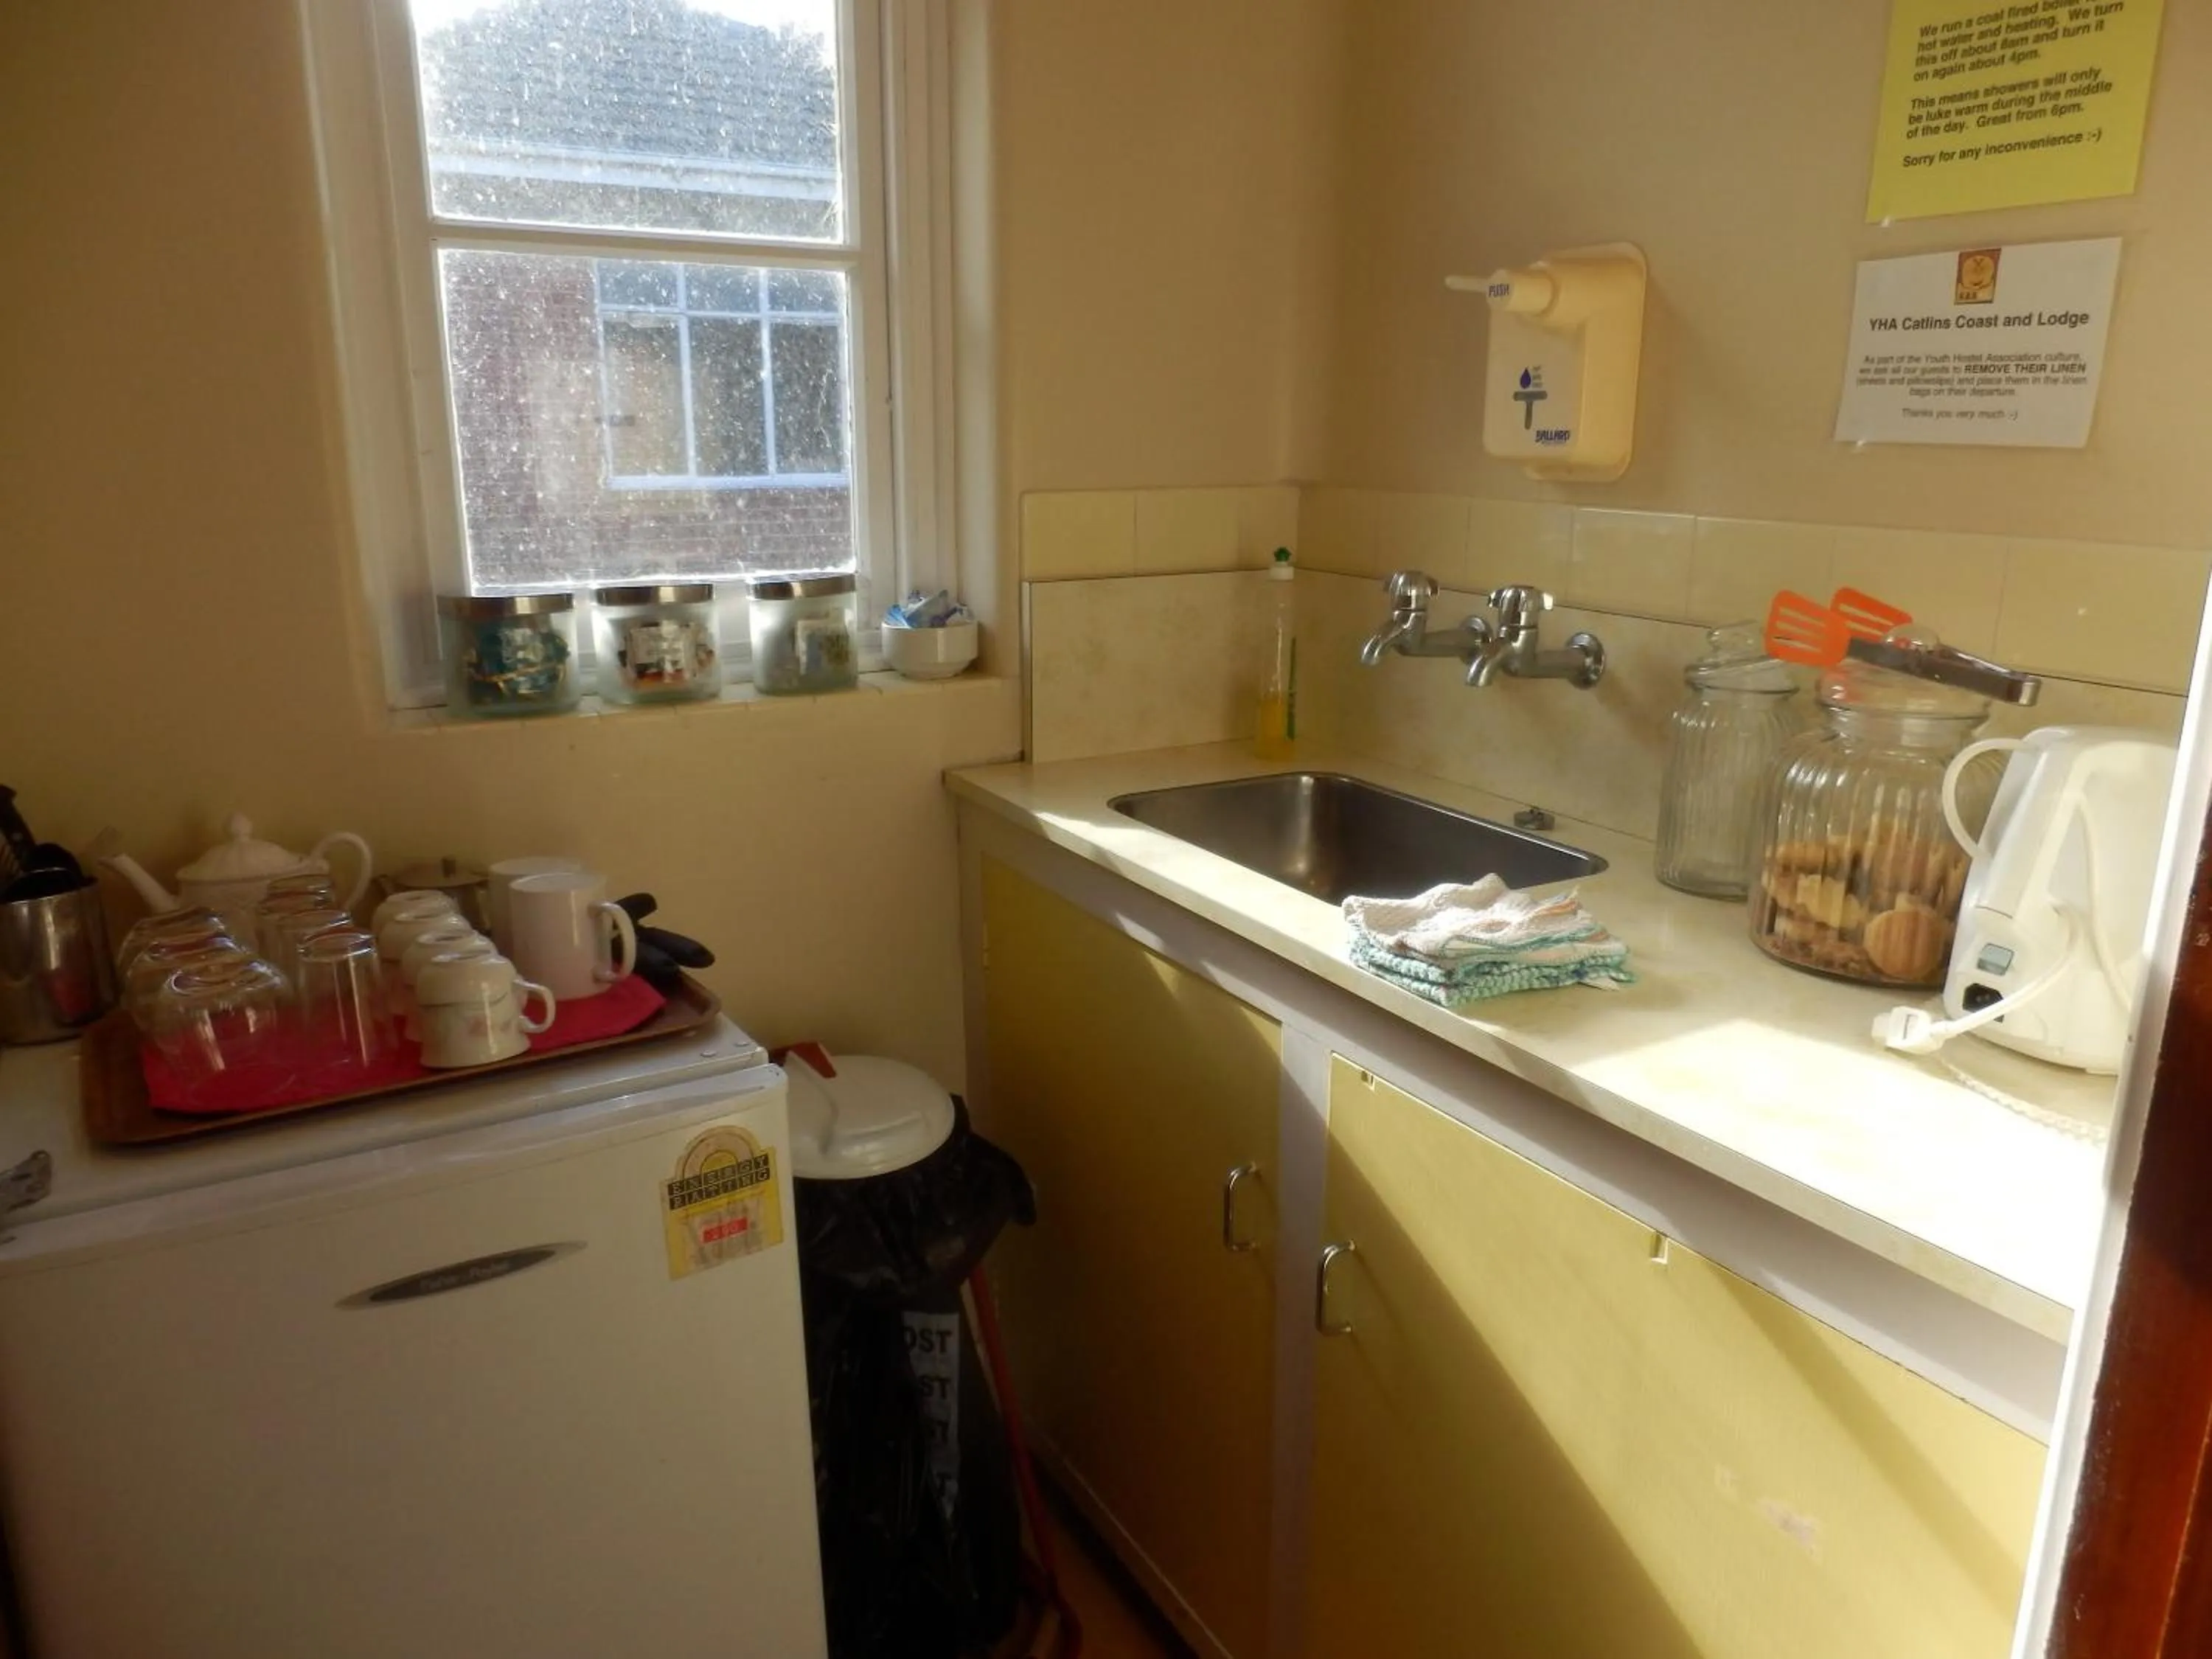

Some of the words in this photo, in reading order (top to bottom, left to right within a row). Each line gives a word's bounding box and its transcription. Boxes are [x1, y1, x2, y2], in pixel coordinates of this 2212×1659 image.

[1917, 39, 1937, 52] hot
[1939, 33, 1975, 47] water
[1977, 24, 2002, 40] and
[2006, 15, 2059, 34] heating.
[2068, 8, 2090, 21] We
[2094, 1, 2124, 16] turn
[1919, 24, 1938, 38] We
[1941, 21, 1962, 32] run
[1965, 18, 1973, 28] a
[1976, 9, 2003, 25] coal
[2008, 2, 2039, 18] fired
[1916, 55, 1938, 67] this
[1941, 49, 1958, 62] off
[1961, 42, 1997, 58] about
[2033, 27, 2059, 44] and
[2062, 24, 2090, 38] turn
[2095, 19, 2104, 32] it
[1913, 71, 1929, 81] on
[1932, 63, 1966, 80] again
[1968, 55, 2005, 71] about
[2010, 49, 2040, 65] 4pm.
[1908, 113, 1924, 125] be
[1925, 108, 1952, 122] luke
[1955, 103, 1989, 116] warm
[1992, 95, 2035, 111] during
[2039, 91, 2061, 104] the
[2065, 81, 2112, 99] middle
[1911, 97, 1935, 111] This
[1938, 89, 1979, 105] means
[1983, 79, 2039, 97] showers
[2042, 72, 2067, 87] will
[2070, 66, 2101, 83] only
[1906, 125, 1919, 139] of
[1921, 125, 1941, 136] the
[1943, 121, 1969, 134] day.
[1976, 112, 2011, 128] Great
[2016, 108, 2047, 122] from
[1902, 155, 1935, 167] Sorry
[1938, 150, 1956, 164] for
[1958, 147, 1981, 161] any
[1984, 133, 2083, 156] inconvenience
[1488, 282, 1510, 297] PUSH
[1870, 317, 1897, 331] YHA
[1902, 316, 1951, 331] Catlins
[1955, 314, 1999, 329] Coast
[2003, 311, 2032, 327] and
[2037, 310, 2089, 329] Lodge
[1924, 354, 1951, 364] Youth
[1964, 364, 2010, 374] REMOVE
[2014, 364, 2048, 374] THEIR
[2051, 364, 2087, 374] LINEN
[2005, 376, 2030, 385] them
